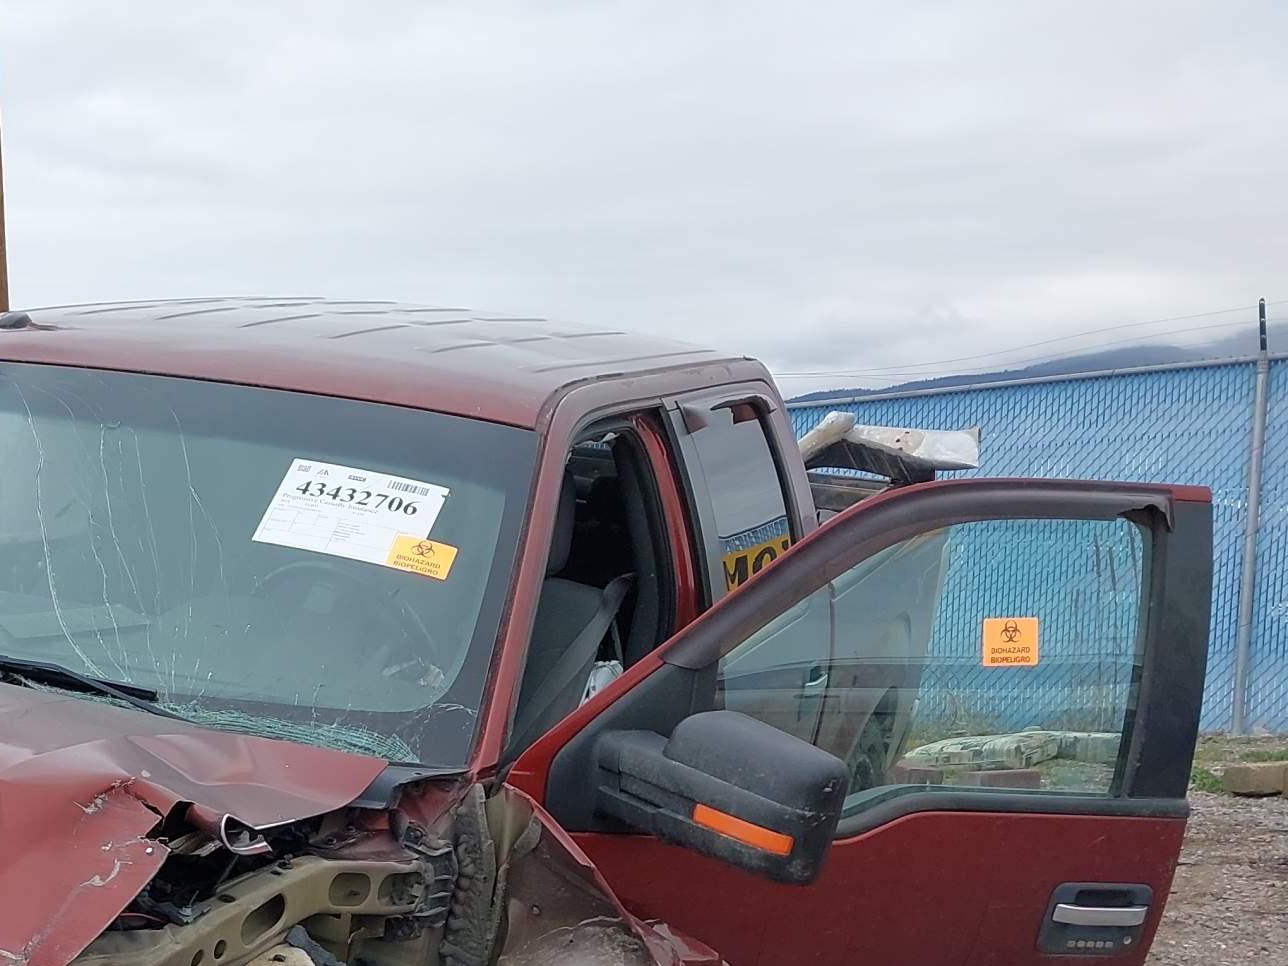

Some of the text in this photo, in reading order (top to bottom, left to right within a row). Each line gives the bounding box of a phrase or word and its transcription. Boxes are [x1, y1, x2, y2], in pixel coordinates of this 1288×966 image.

[296, 480, 422, 516] 43432706
[392, 560, 439, 576] BIOPELIGRO
[395, 553, 441, 569] BIOHAZARD
[991, 646, 1031, 655] BIOHAZARD
[990, 655, 1031, 664] BIOPELIGRO
